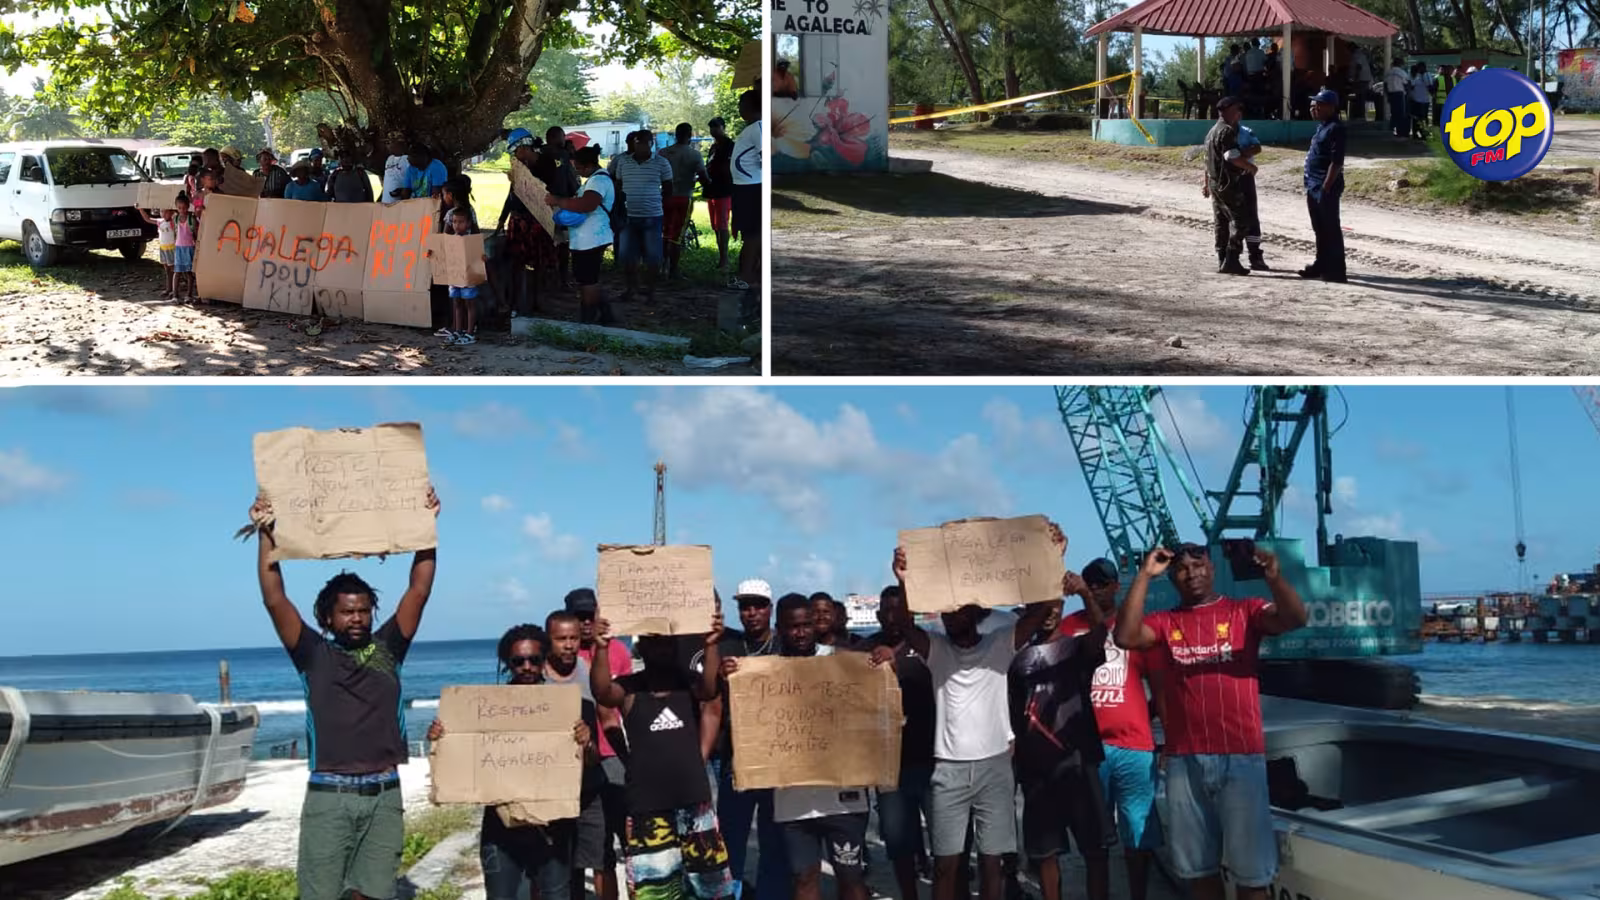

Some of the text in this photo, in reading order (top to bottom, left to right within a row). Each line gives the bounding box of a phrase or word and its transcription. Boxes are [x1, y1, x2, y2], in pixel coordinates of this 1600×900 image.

[802, 0, 829, 14] TO
[784, 15, 867, 35] AGALEGA
[1306, 600, 1394, 627] OBELCO
